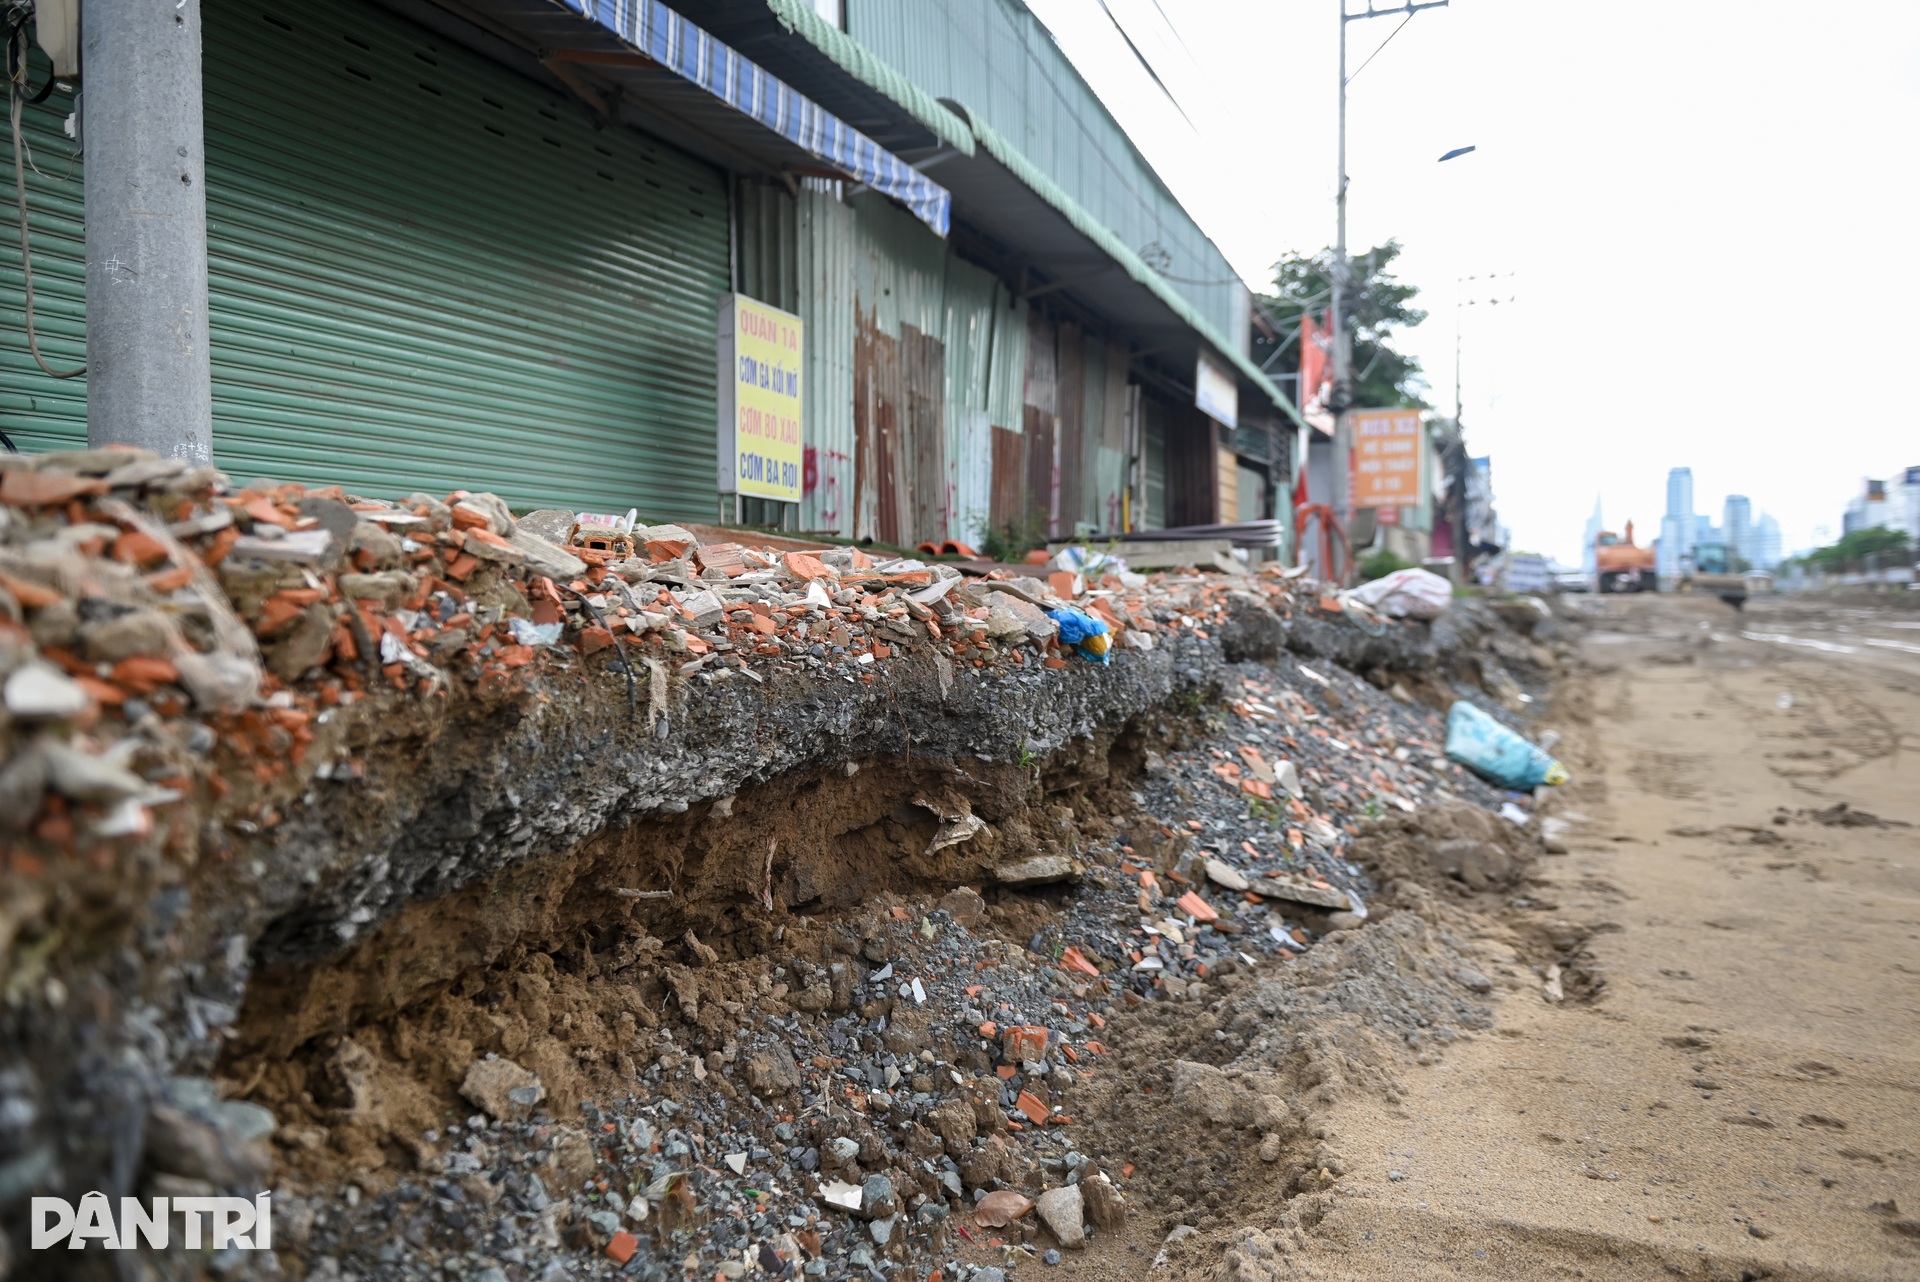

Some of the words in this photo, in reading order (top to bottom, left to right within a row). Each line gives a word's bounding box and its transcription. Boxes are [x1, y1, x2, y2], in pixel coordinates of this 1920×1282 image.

[741, 309, 776, 344] QUÁN
[782, 326, 797, 352] 1A
[740, 355, 757, 386] CƠM
[760, 357, 769, 390] GÀ
[772, 360, 784, 394] XỐI
[740, 406, 761, 436] CƠM
[765, 408, 777, 440] BÒ
[740, 452, 763, 482] CƠM
[766, 457, 779, 485] BA
[782, 461, 797, 494] RỌI
